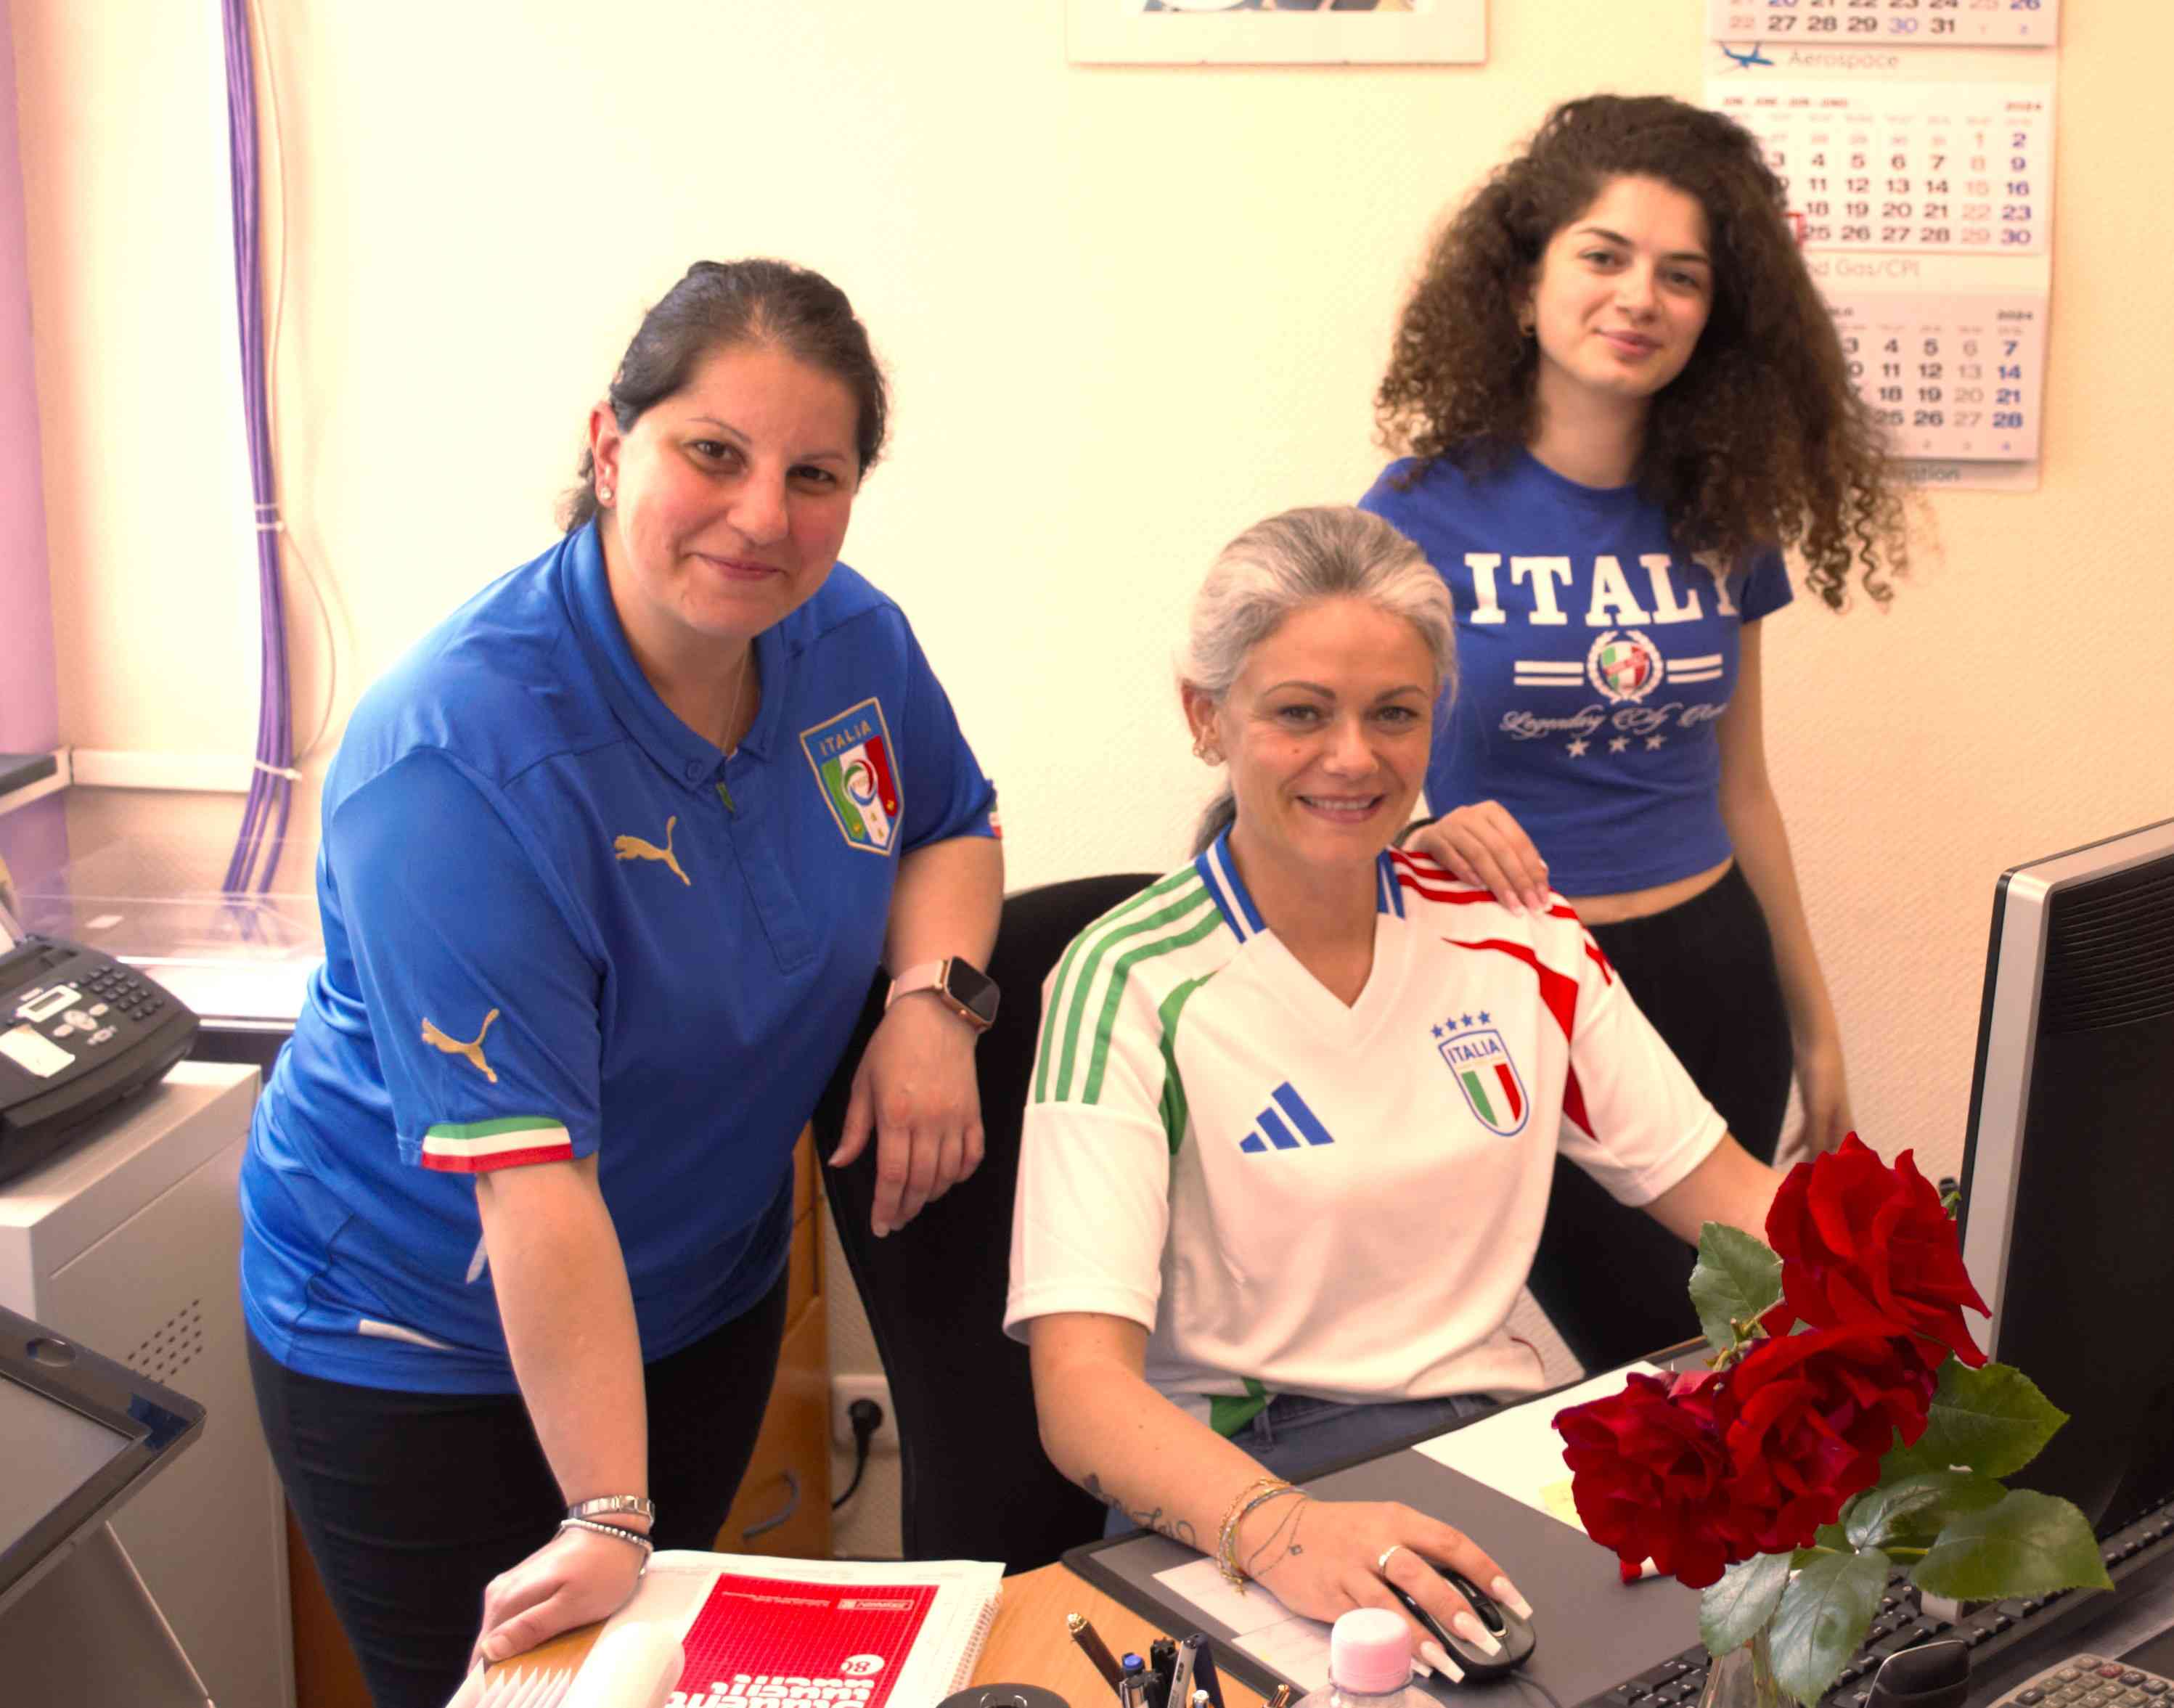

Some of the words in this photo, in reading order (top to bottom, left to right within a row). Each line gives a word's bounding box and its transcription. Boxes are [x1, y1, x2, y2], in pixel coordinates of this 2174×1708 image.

[1768, 16, 1797, 31] 27
[1807, 16, 1837, 31] 28
[1848, 17, 1879, 32] 29
[1889, 17, 1918, 33] 30
[1930, 17, 1955, 33] 31
[1789, 49, 1899, 69] Aerospace
[2012, 133, 2026, 147] 2
[1812, 153, 1825, 167] 4
[1852, 154, 1865, 168] 5
[1891, 155, 1905, 169] 6
[1931, 155, 1945, 170] 7
[2011, 157, 2026, 171] 9
[1810, 178, 1826, 191] 11
[1847, 178, 1868, 192] 12
[1888, 179, 1910, 193] 13
[1927, 179, 1948, 193] 14
[2007, 181, 2030, 196] 16
[1807, 201, 1828, 216] 18
[1847, 202, 1868, 217] 19
[1883, 203, 1912, 218] 20
[1924, 203, 1948, 218] 21
[2002, 205, 2031, 221] 23
[1842, 226, 1871, 241] 26
[1883, 227, 1911, 242] 27
[1921, 227, 1950, 242] 28
[2002, 229, 2031, 245] 30
[1884, 338, 1899, 354] 4
[1924, 338, 1938, 356] 5
[1963, 340, 1978, 356] 6
[2004, 340, 2018, 356] 7
[1883, 364, 1900, 377] 11
[1918, 363, 1942, 378] 12
[1958, 364, 1982, 379] 13
[1998, 364, 2021, 380] 14
[1879, 386, 1902, 402] 18
[1918, 387, 1942, 403] 19
[1955, 388, 1984, 403] 20
[1997, 388, 2021, 404] 21
[1913, 411, 1943, 427] 26
[1954, 412, 1983, 427] 27
[1993, 412, 2023, 428] 28
[1464, 552, 1738, 627] ITALY
[820, 720, 872, 756] ITALIA
[1447, 1039, 1500, 1063] ITALIA
